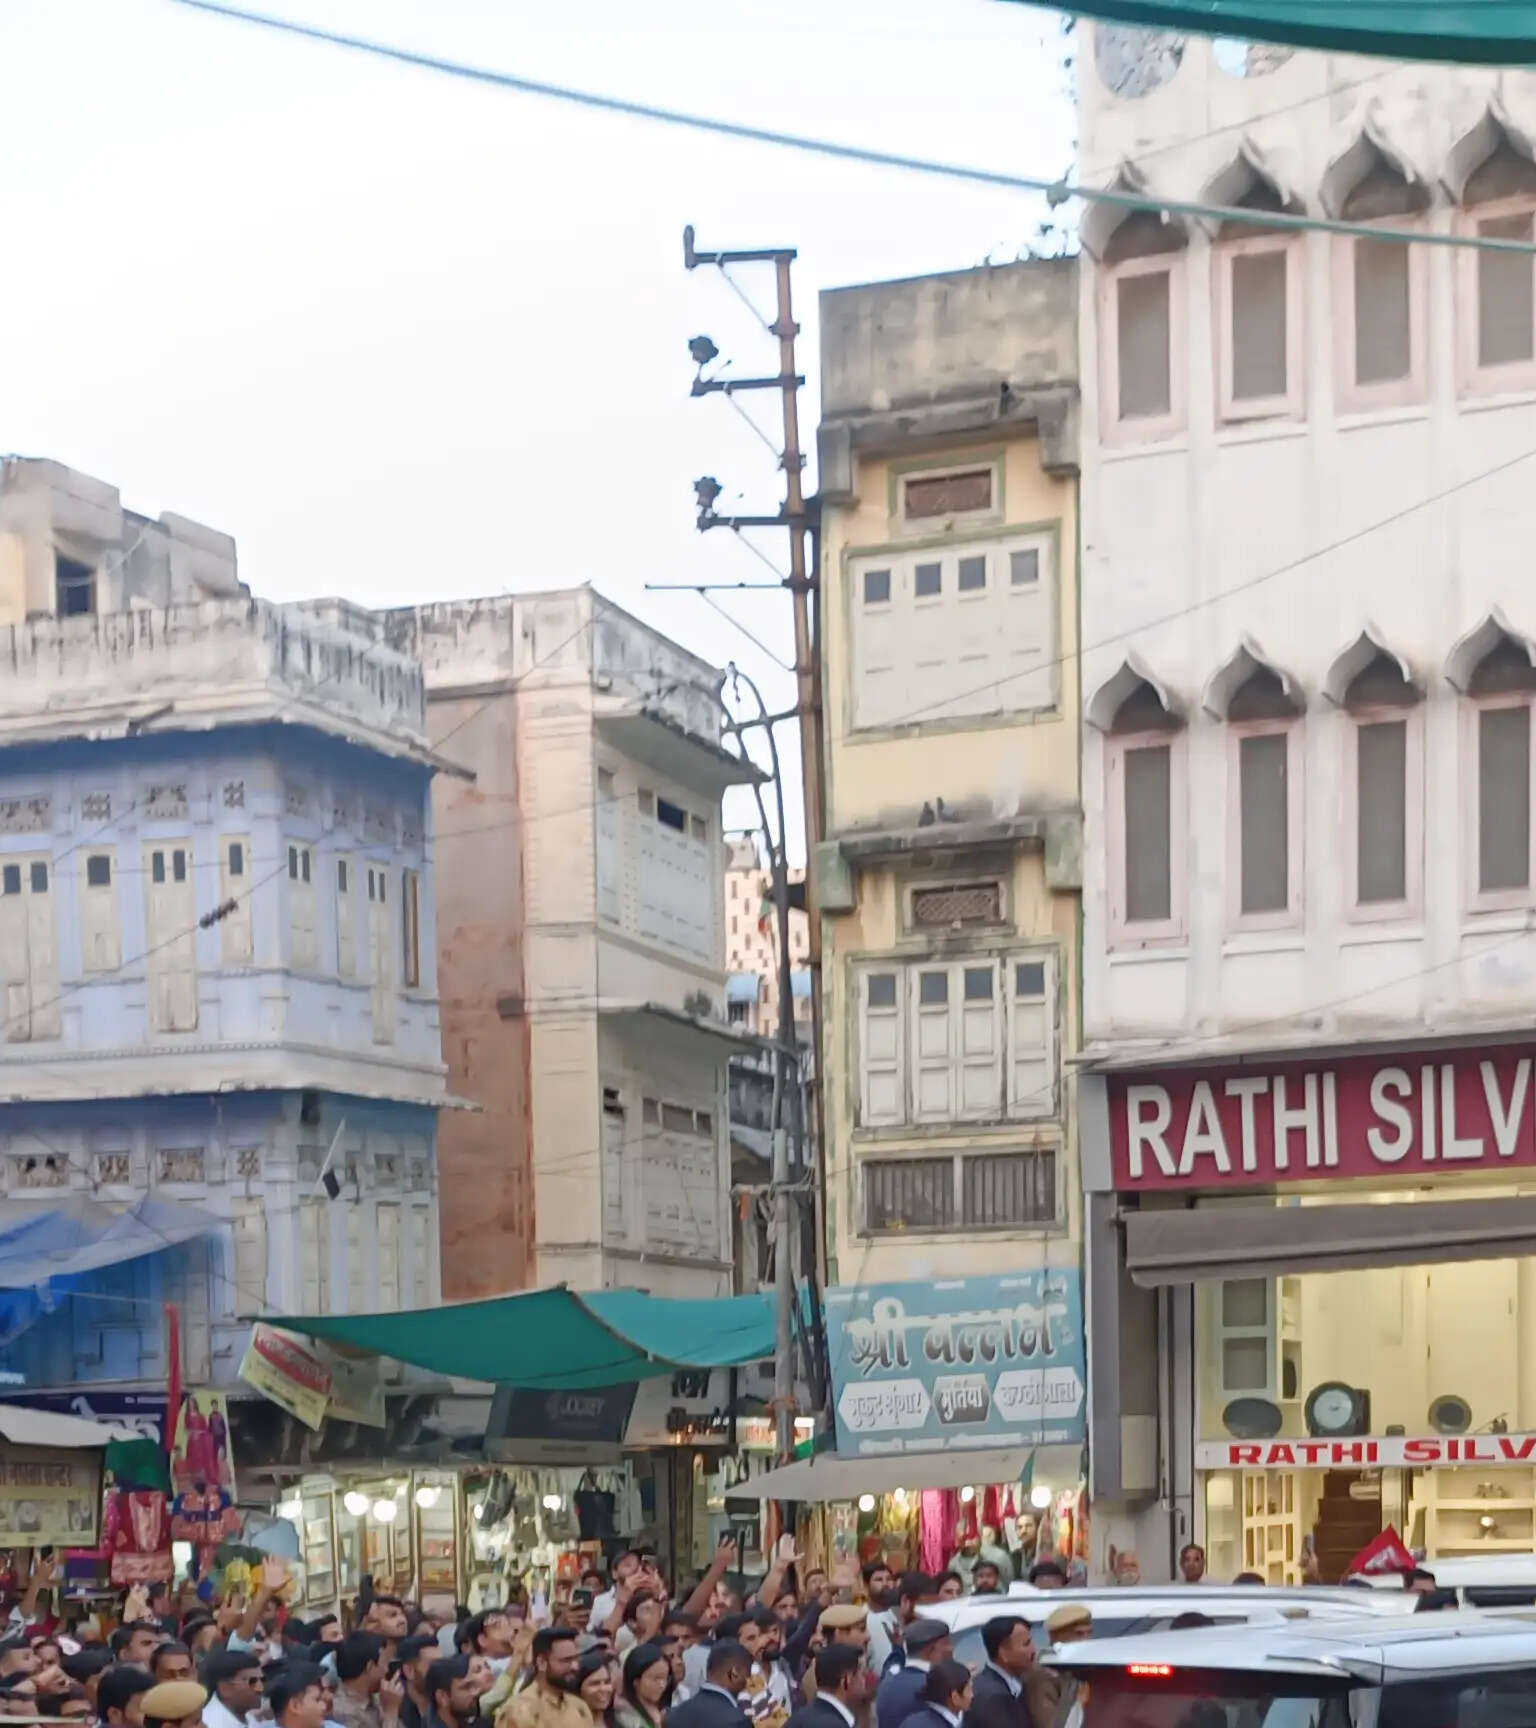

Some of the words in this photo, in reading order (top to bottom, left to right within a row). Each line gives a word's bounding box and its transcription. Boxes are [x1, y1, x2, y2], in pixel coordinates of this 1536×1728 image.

[1126, 1071, 1339, 1178] RATHI
[842, 1297, 910, 1377] श्री
[920, 1303, 1068, 1364] वल्लभ
[1228, 1441, 1378, 1465] RATHI
